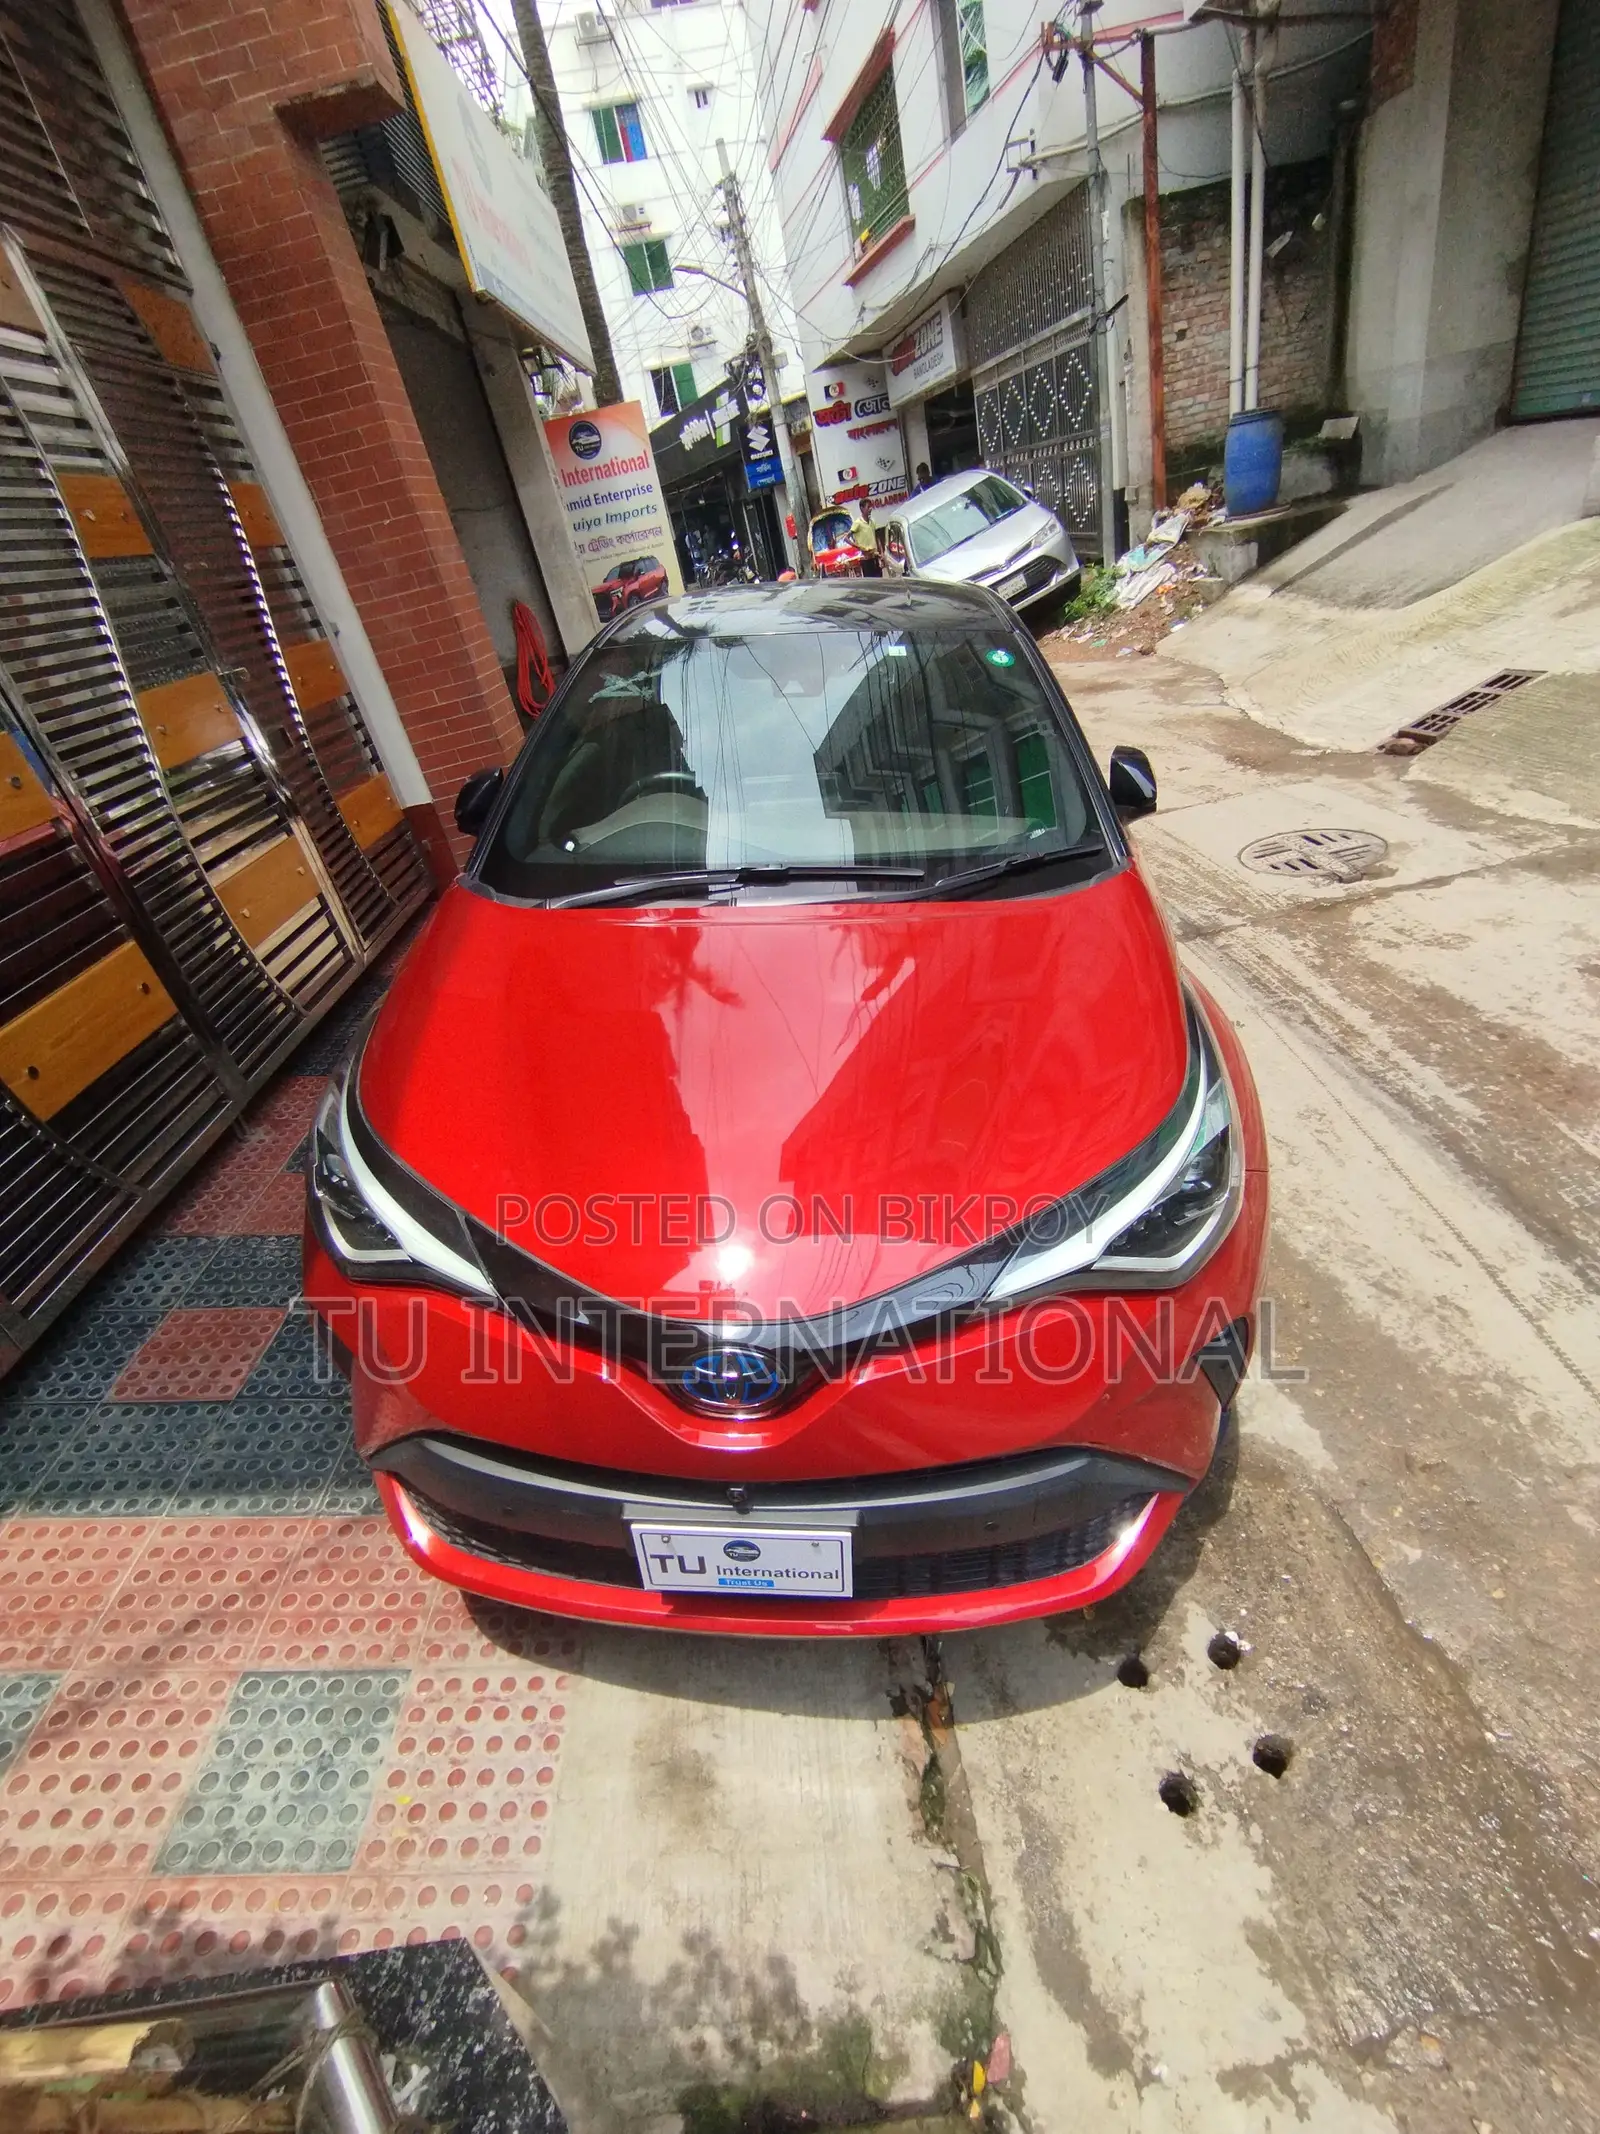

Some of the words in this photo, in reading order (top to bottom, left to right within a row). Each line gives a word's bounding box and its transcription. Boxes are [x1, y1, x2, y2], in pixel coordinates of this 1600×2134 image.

[913, 351, 943, 379] BANGLADESH
[561, 450, 650, 487] International
[594, 483, 653, 505] Enterprise
[572, 517, 601, 532] uiya
[606, 504, 657, 524] Imports
[650, 1554, 707, 1575] TU
[716, 1565, 839, 1580] International
